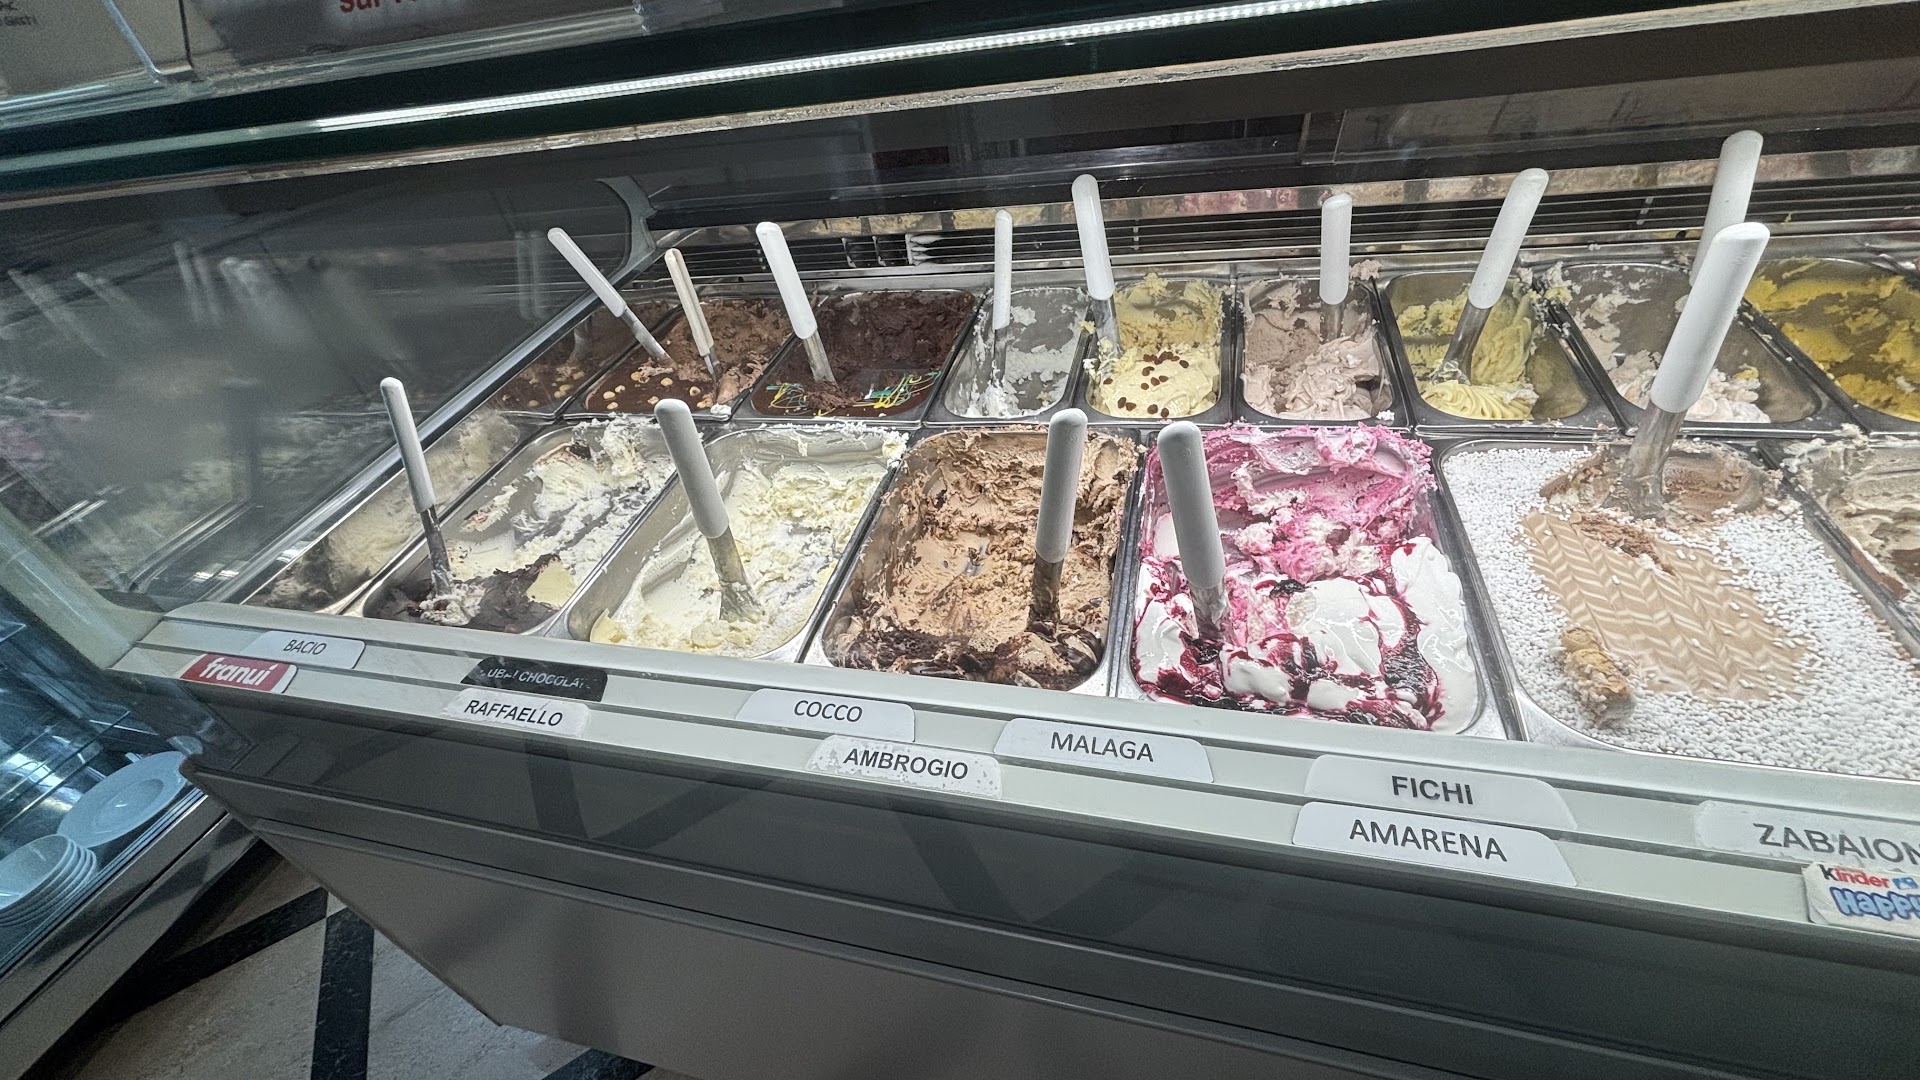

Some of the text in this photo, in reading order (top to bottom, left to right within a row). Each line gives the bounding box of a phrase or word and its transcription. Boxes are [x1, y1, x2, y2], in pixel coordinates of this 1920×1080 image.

[283, 639, 327, 655] BACIO
[464, 700, 563, 726] RAFFAELLO
[794, 700, 863, 722] COCCO
[1050, 731, 1154, 762] MALAGA
[843, 748, 968, 779] AMBROGIO
[1392, 775, 1473, 805] FICHI
[1350, 819, 1507, 862] AMARENA
[1753, 823, 1920, 866] ZABAION
